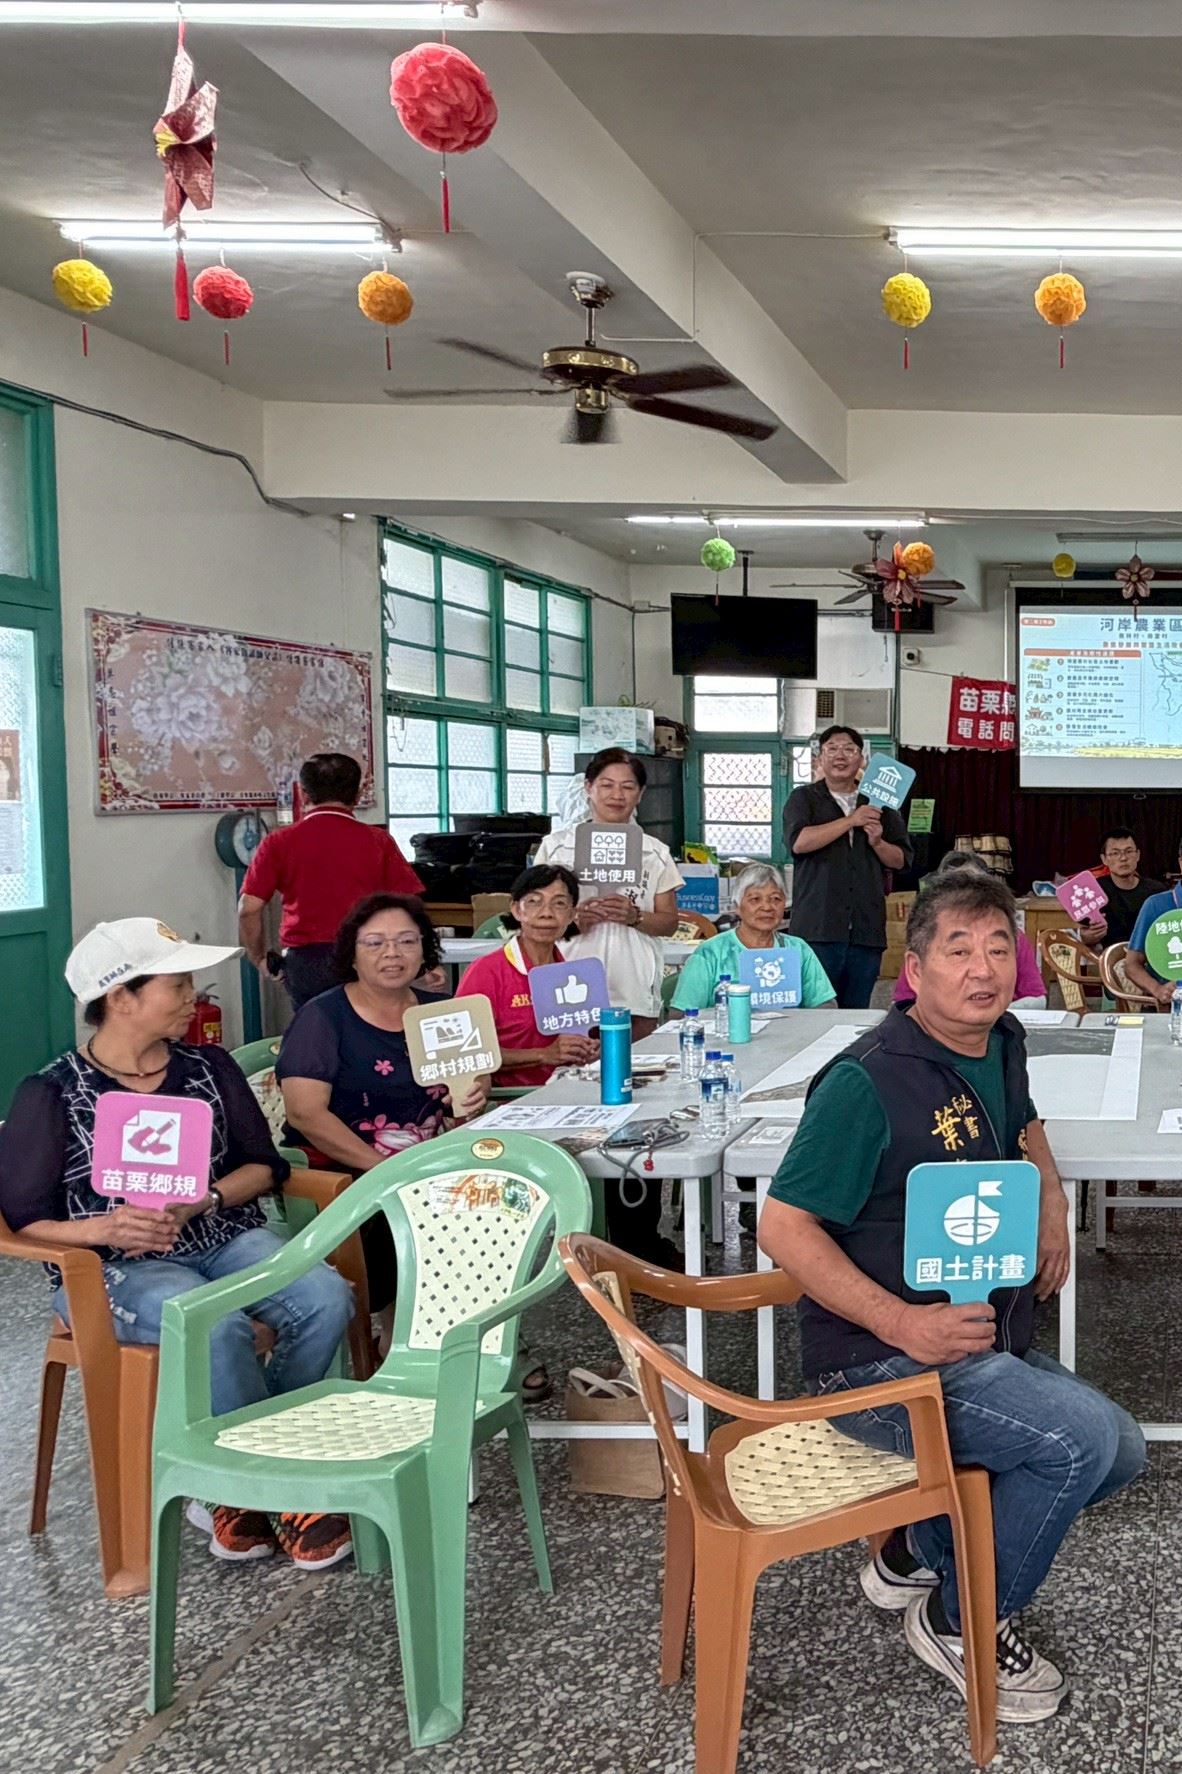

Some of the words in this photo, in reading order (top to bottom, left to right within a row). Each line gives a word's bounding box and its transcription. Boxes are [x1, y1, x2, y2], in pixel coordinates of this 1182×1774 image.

[957, 717, 1014, 742] 電話問
[579, 868, 636, 883] 土地使用
[542, 1007, 601, 1031] 地方特色
[420, 1051, 494, 1082] 鄉村規劃
[931, 1106, 965, 1151] 葉
[951, 1094, 980, 1139] 秘書
[101, 1168, 197, 1197] 苗栗鄉規
[916, 1254, 1026, 1284] 國土計畫
